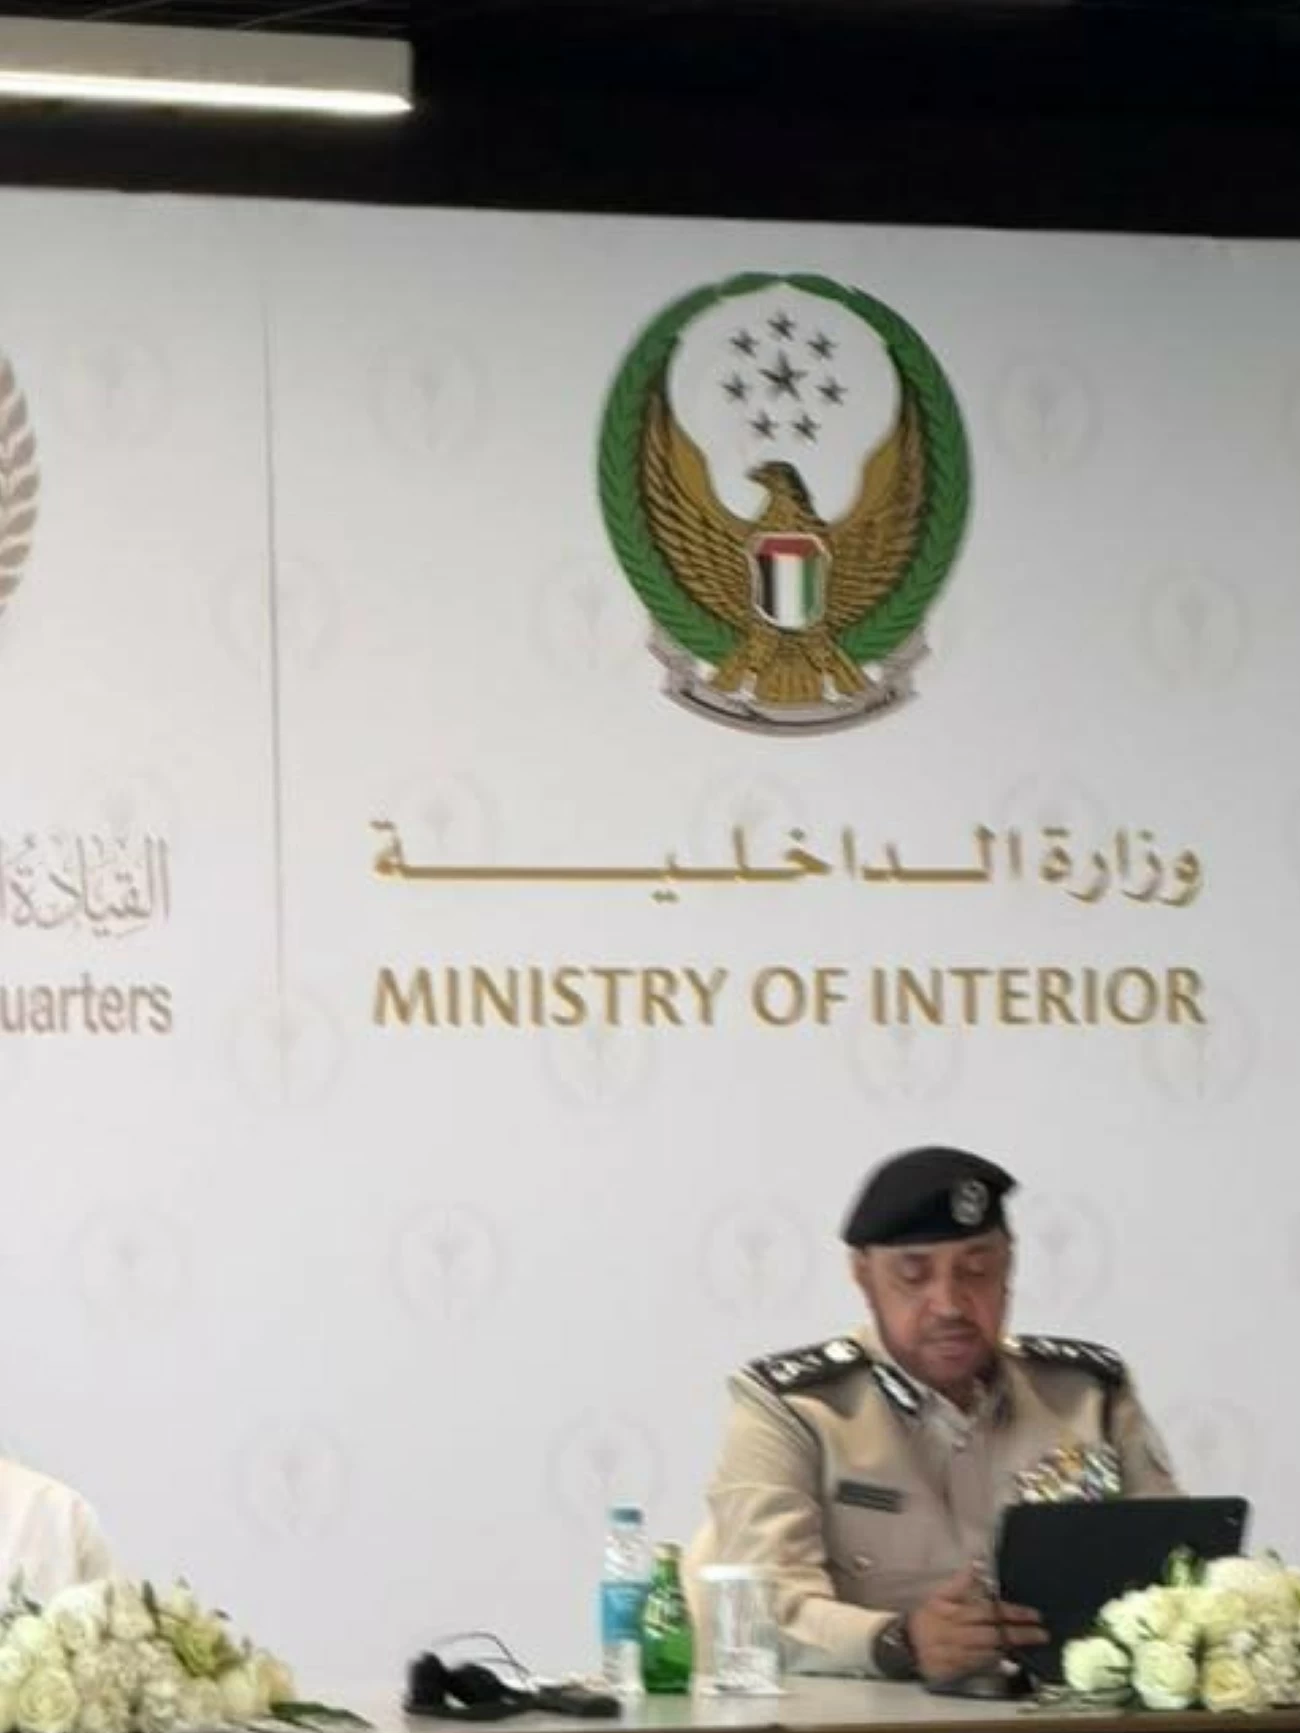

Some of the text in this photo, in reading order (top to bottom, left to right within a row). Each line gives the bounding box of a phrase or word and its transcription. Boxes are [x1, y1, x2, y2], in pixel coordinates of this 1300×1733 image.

[1040, 823, 1203, 908] وزارة
[373, 964, 1207, 1028] MINISTRY OF INTERIOR
